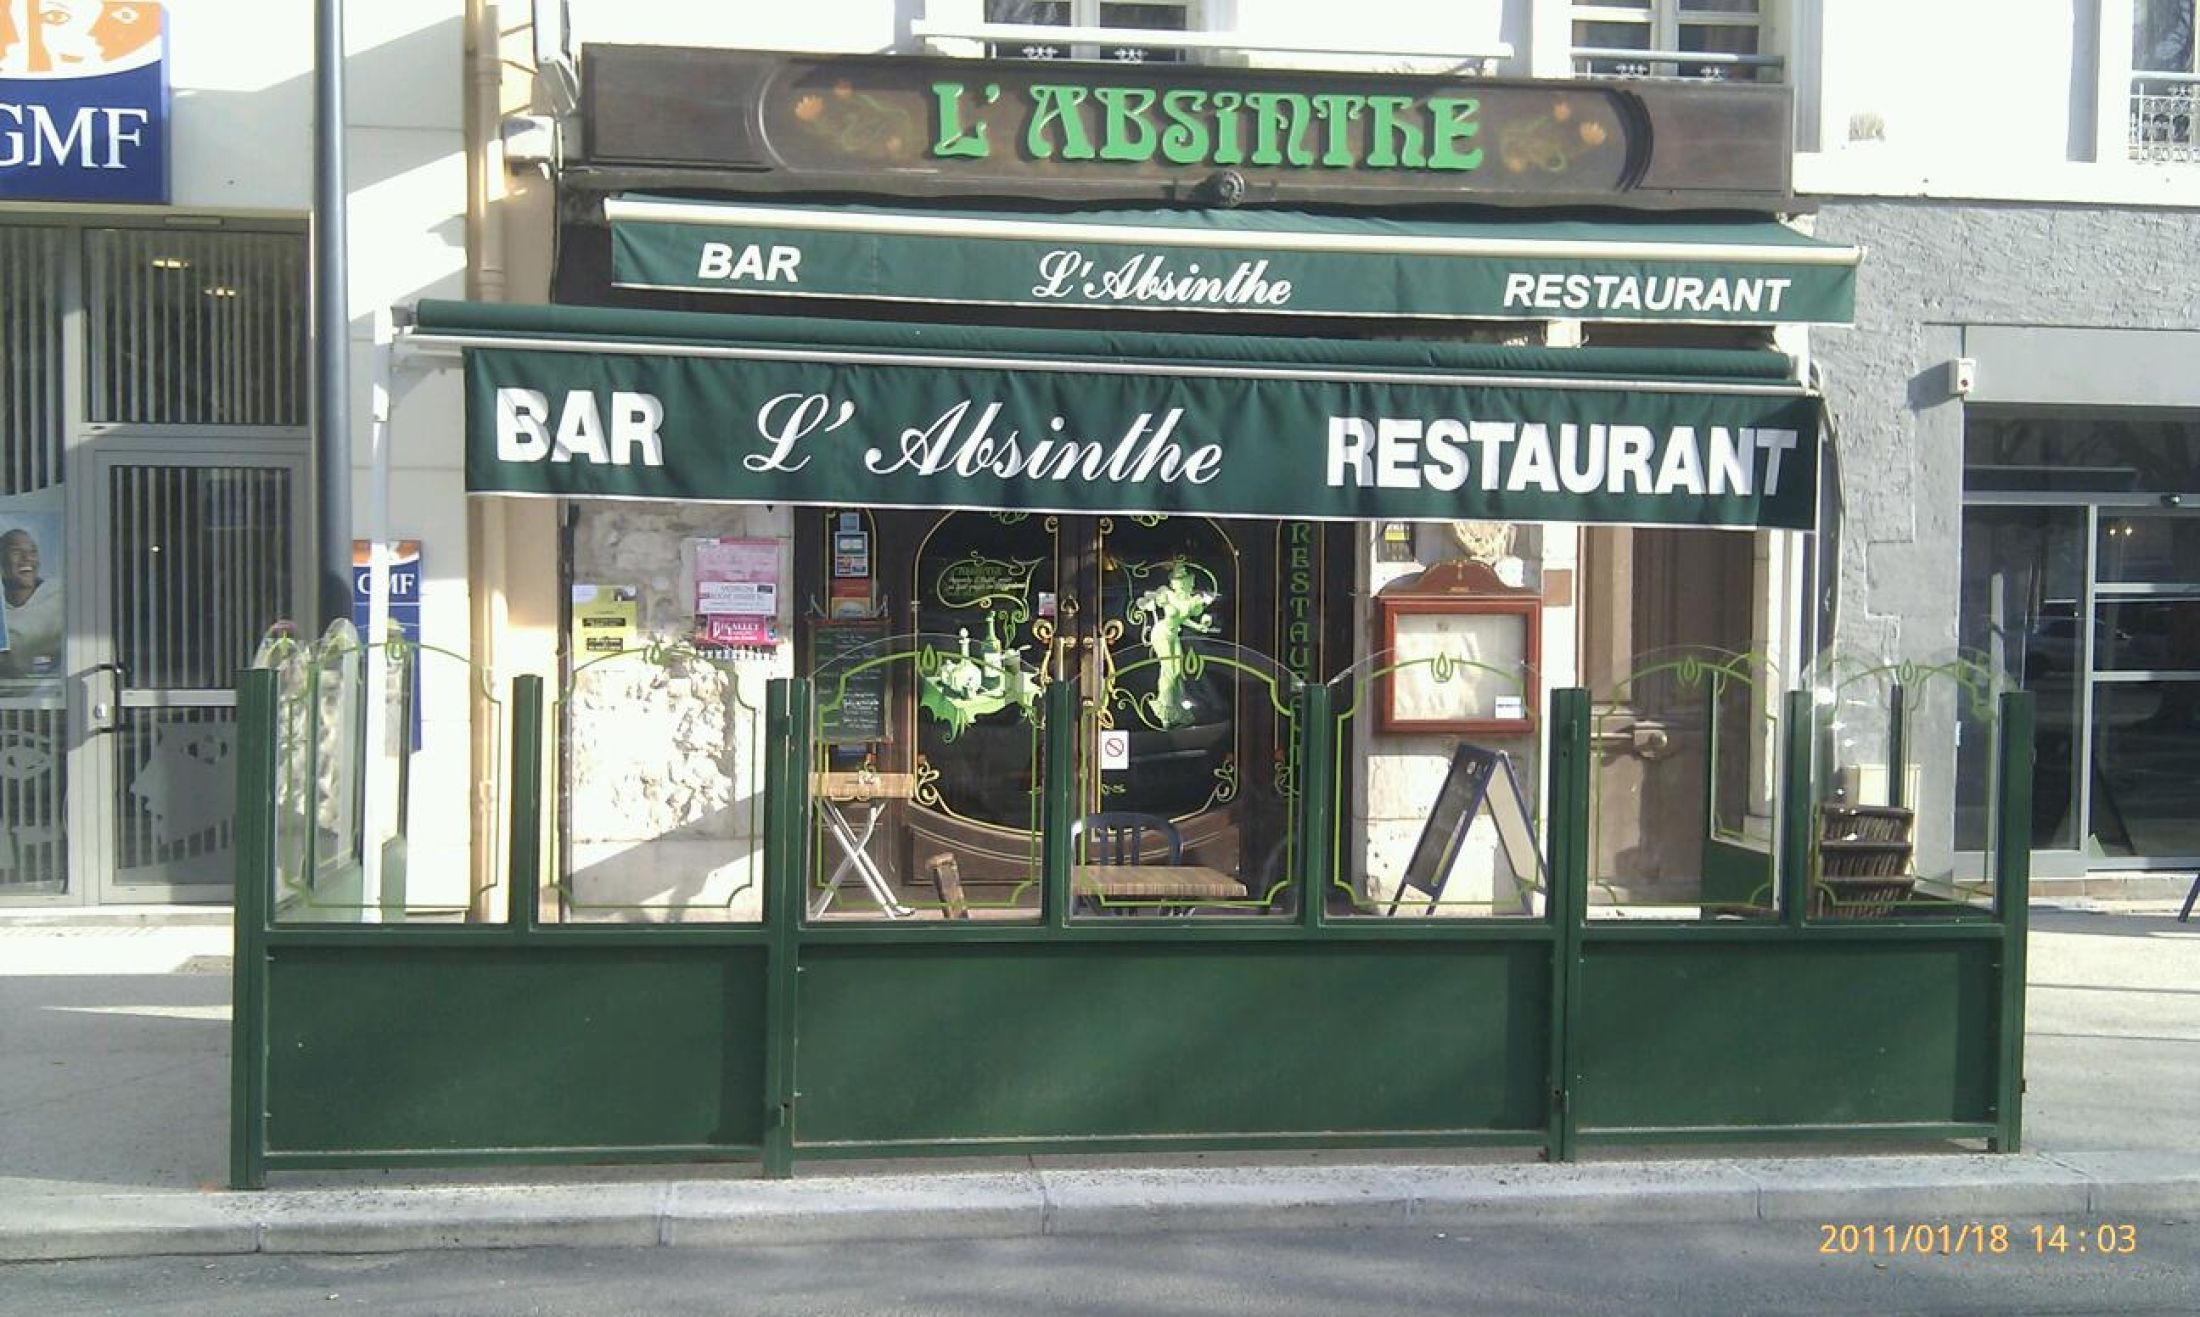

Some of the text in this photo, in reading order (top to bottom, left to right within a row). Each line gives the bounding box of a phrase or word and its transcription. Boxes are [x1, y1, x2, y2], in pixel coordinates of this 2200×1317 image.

[699, 243, 1791, 314] BAR L'Absinthe RESTAURANT
[496, 387, 664, 467] BAR
[1326, 415, 1798, 497] RESTAURANT
